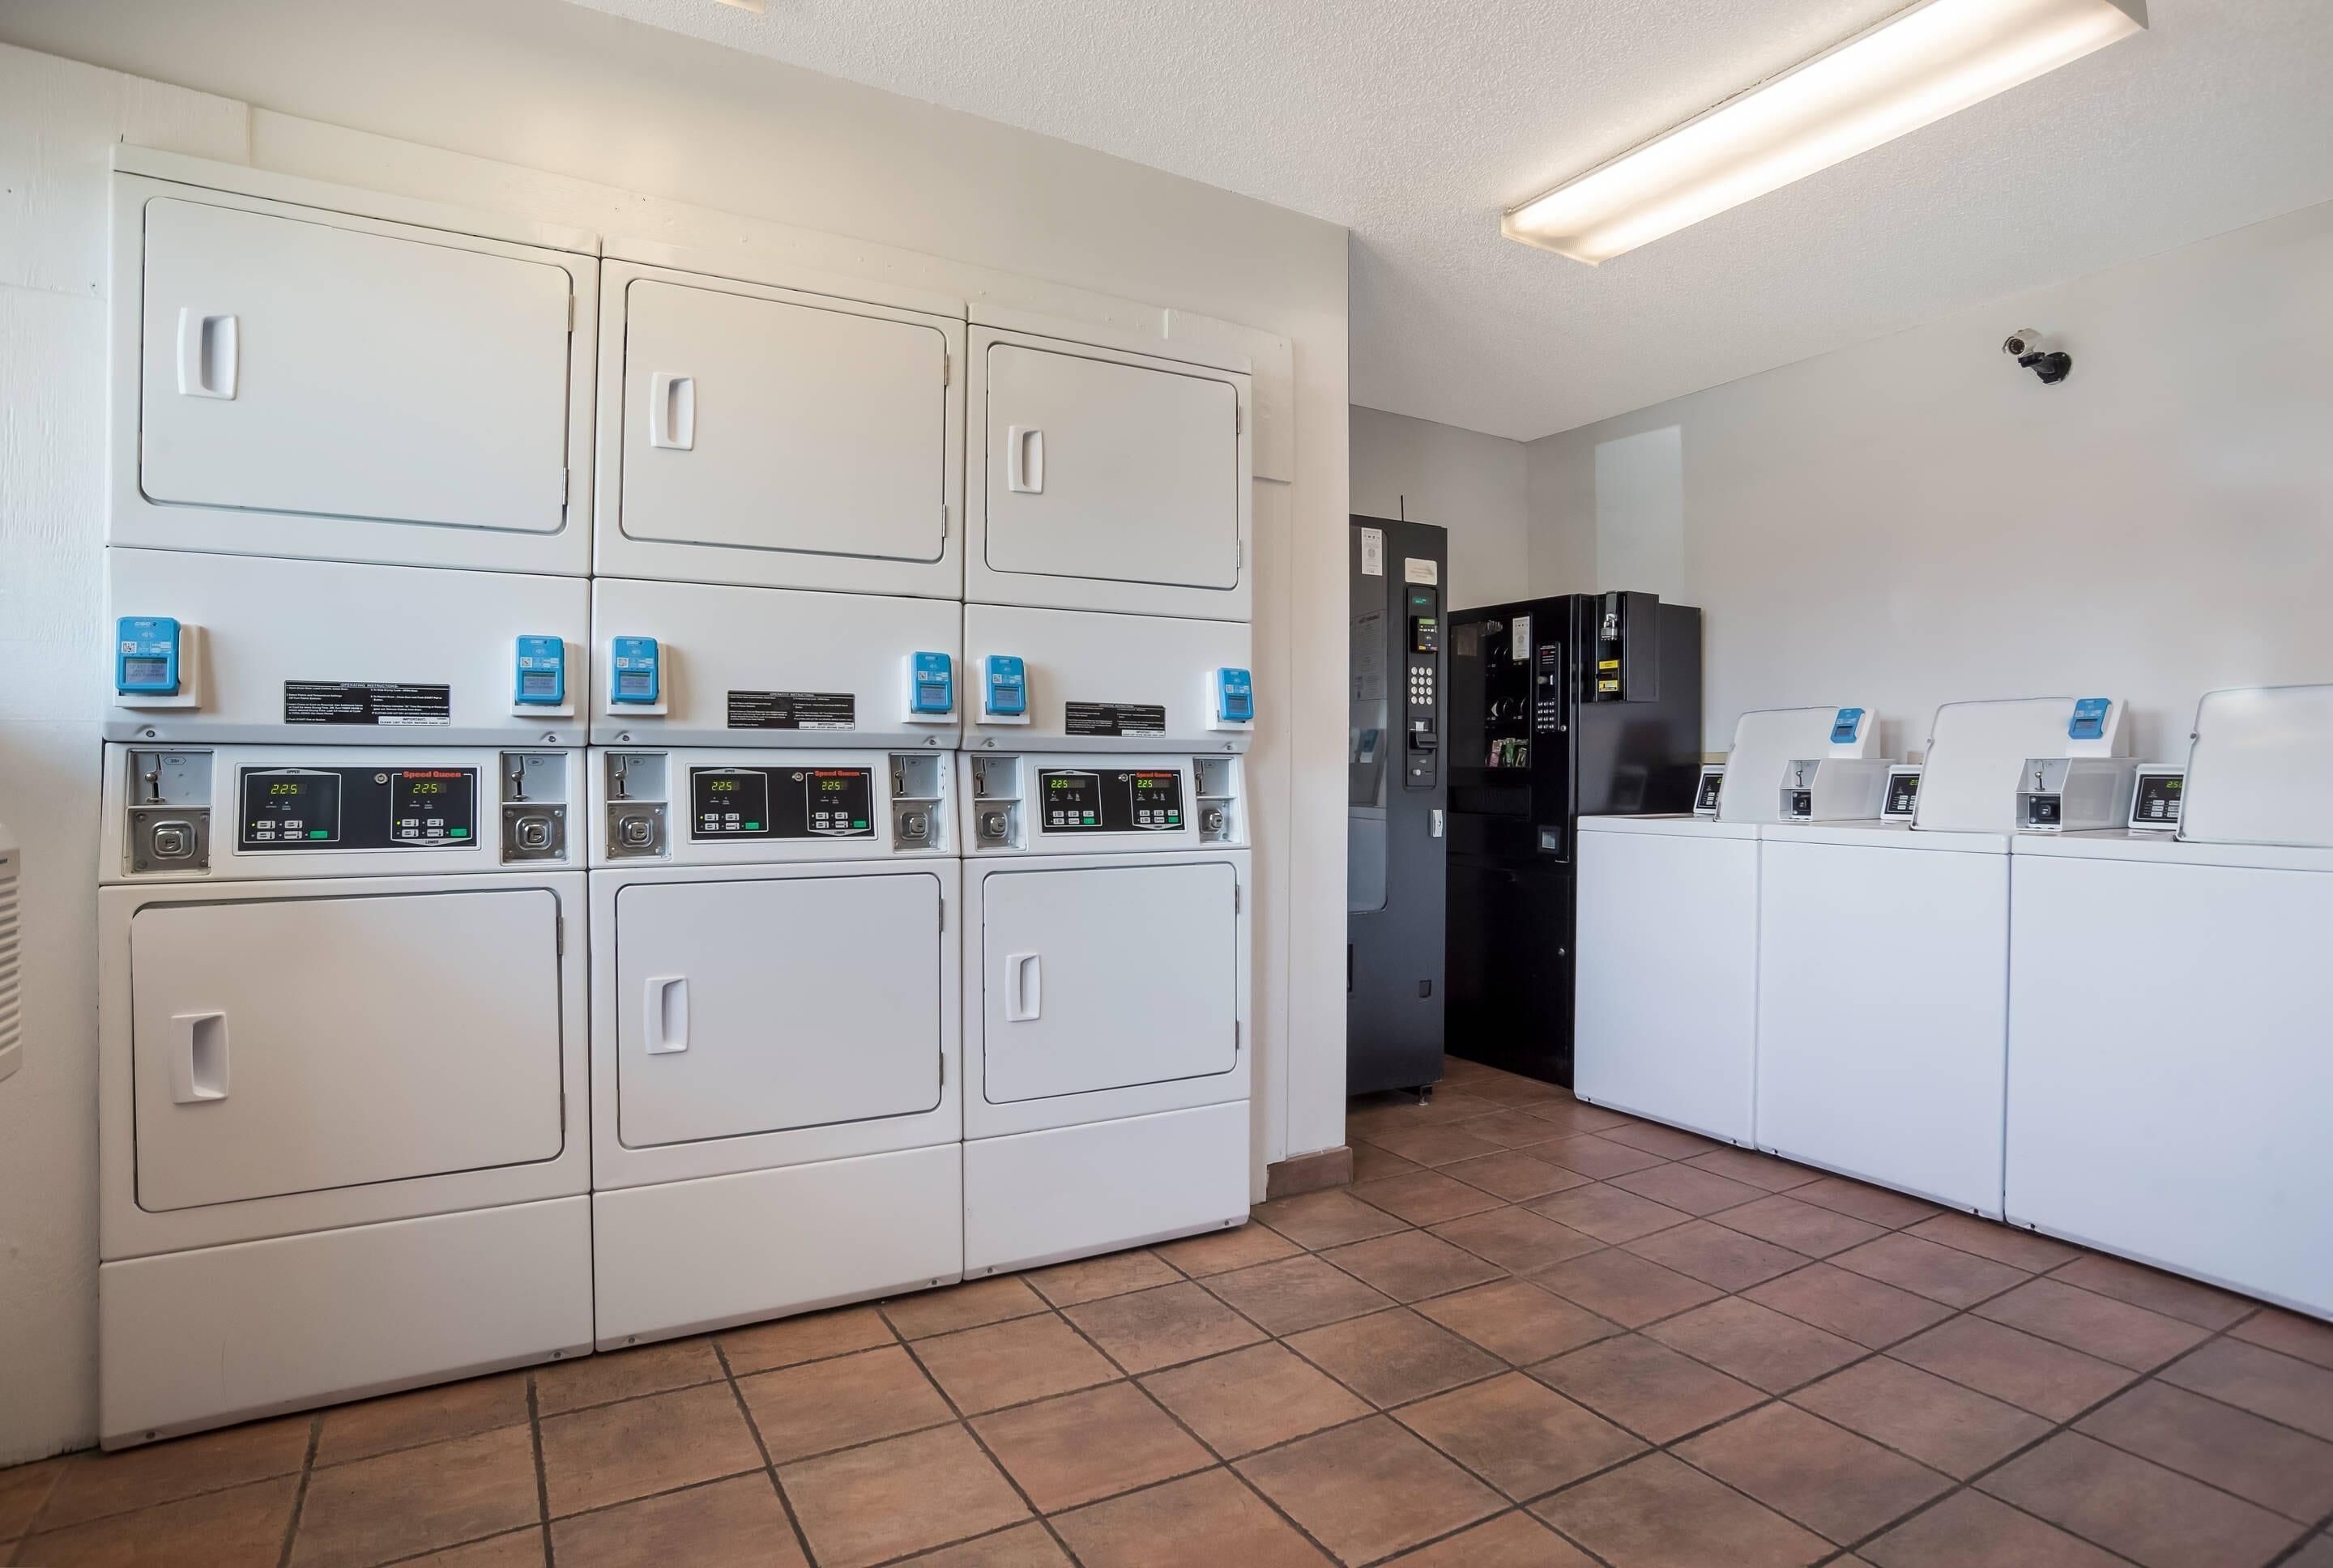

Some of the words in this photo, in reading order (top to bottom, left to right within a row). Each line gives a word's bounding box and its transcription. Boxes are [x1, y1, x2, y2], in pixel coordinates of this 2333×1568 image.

[403, 771, 432, 779] Speed
[271, 784, 297, 795] 225
[413, 783, 437, 794] 225
[711, 782, 732, 790] 225
[821, 782, 840, 790] 225
